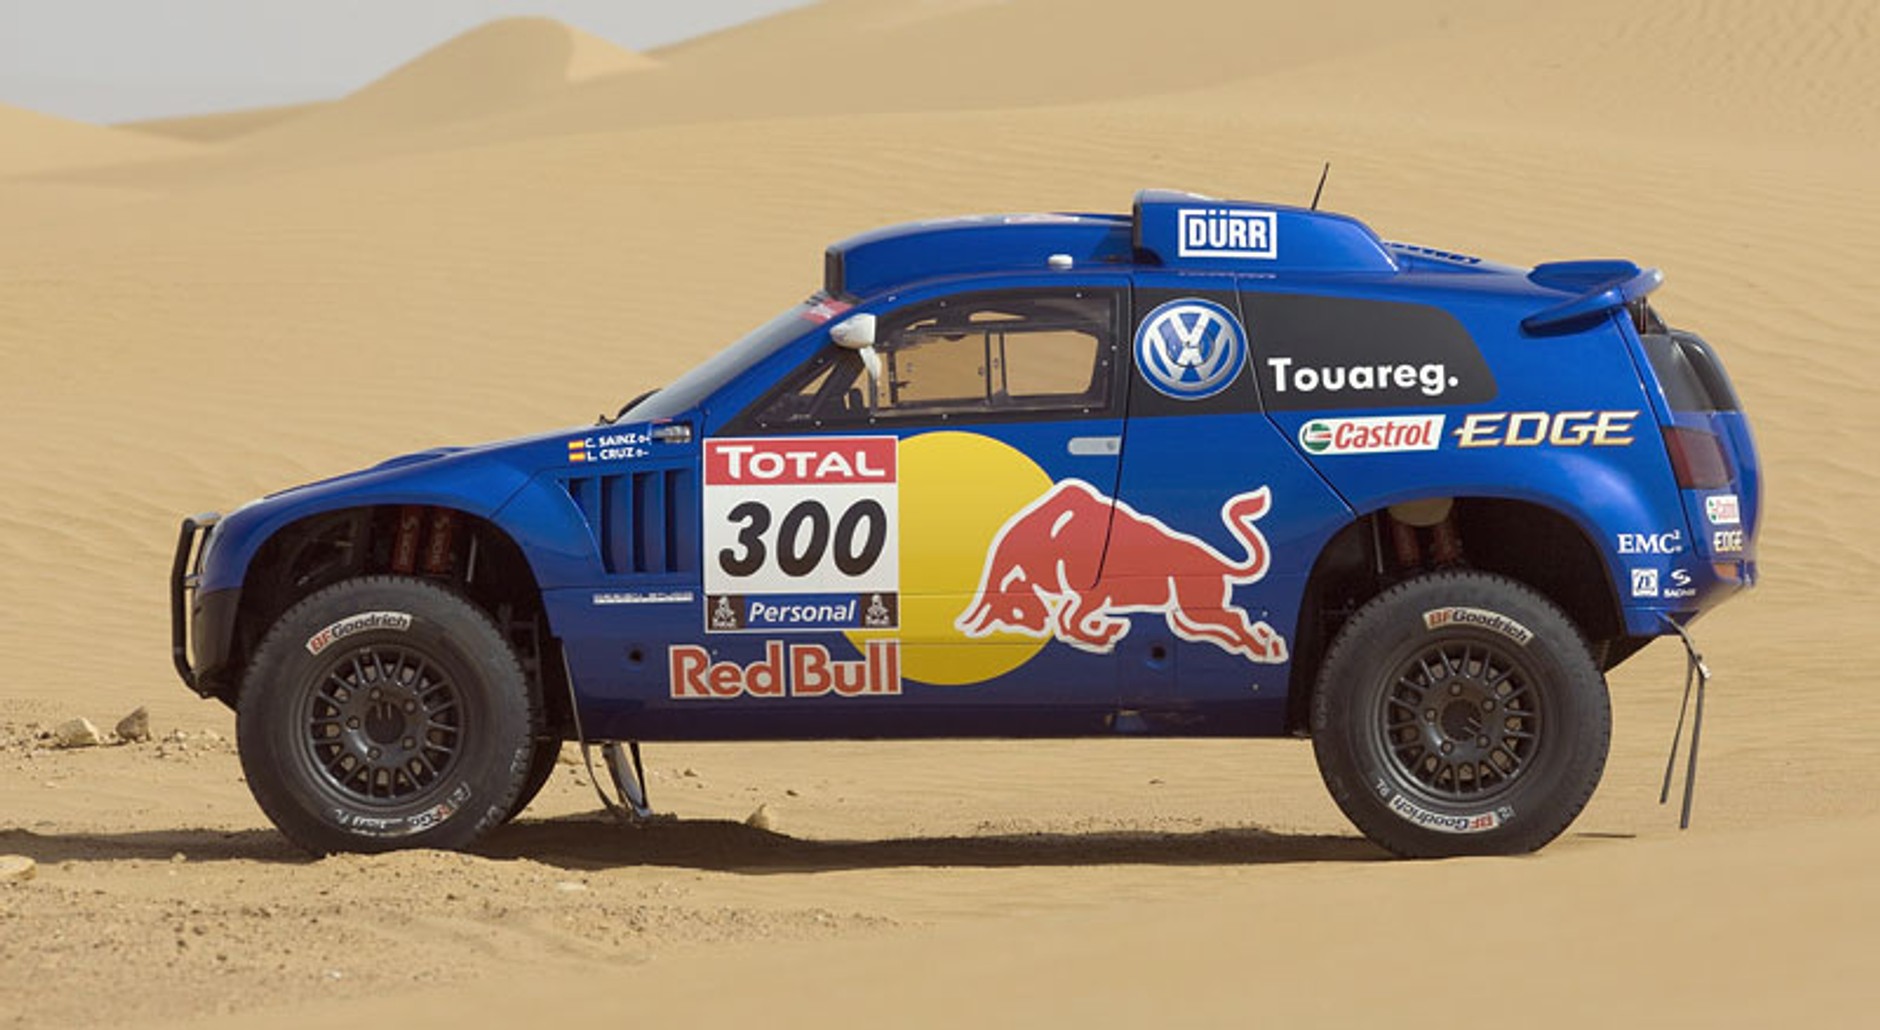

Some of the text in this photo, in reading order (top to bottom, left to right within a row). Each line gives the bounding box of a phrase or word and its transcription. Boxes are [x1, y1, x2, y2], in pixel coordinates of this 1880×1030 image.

[1188, 210, 1268, 249] DÜRR
[1268, 357, 1459, 395] Touareg.
[599, 434, 637, 447] SAINZ
[1335, 410, 1641, 449] Castrol EDGE
[599, 447, 635, 460] CRUZ
[715, 445, 886, 479] TOTAL
[719, 499, 887, 577] 300
[749, 600, 857, 622] Personal
[1429, 608, 1528, 643] BFGoodrich
[310, 613, 408, 652] BFGoodrich
[669, 639, 903, 699] Red Bull
[1394, 794, 1494, 831] BFGoodrich
